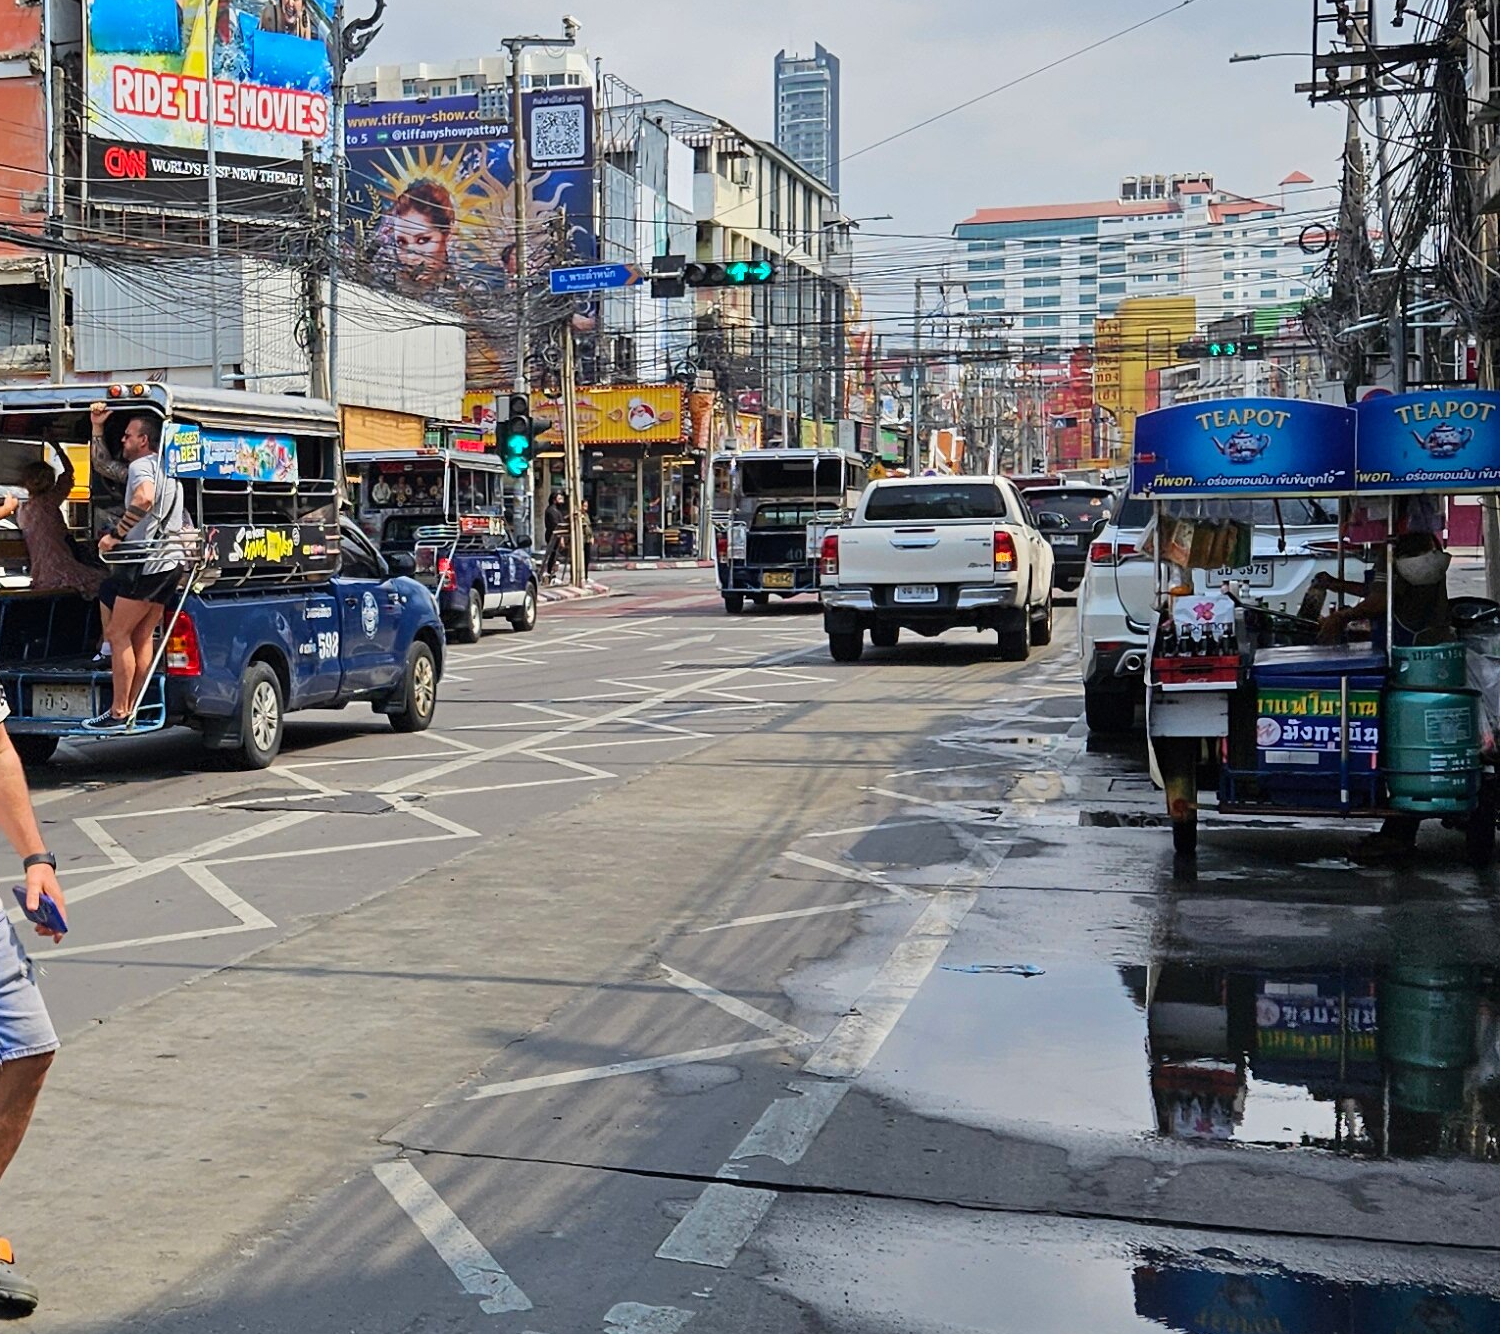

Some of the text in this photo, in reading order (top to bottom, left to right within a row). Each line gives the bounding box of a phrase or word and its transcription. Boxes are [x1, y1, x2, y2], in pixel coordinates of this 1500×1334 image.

[114, 67, 326, 135] RIDE THE MOVIES
[347, 110, 481, 128] www.tiffany-show.co
[347, 134, 358, 144] to
[361, 134, 368, 144] 5
[392, 124, 508, 142] @tiffanyshowpattaya
[104, 146, 147, 179] CNN
[151, 158, 201, 176] WORLD'S
[233, 166, 257, 181] NEW
[260, 170, 298, 186] THEME
[1196, 408, 1290, 431] TEAPOT
[1394, 401, 1496, 424] TEAPOT
[317, 632, 339, 659] 598
